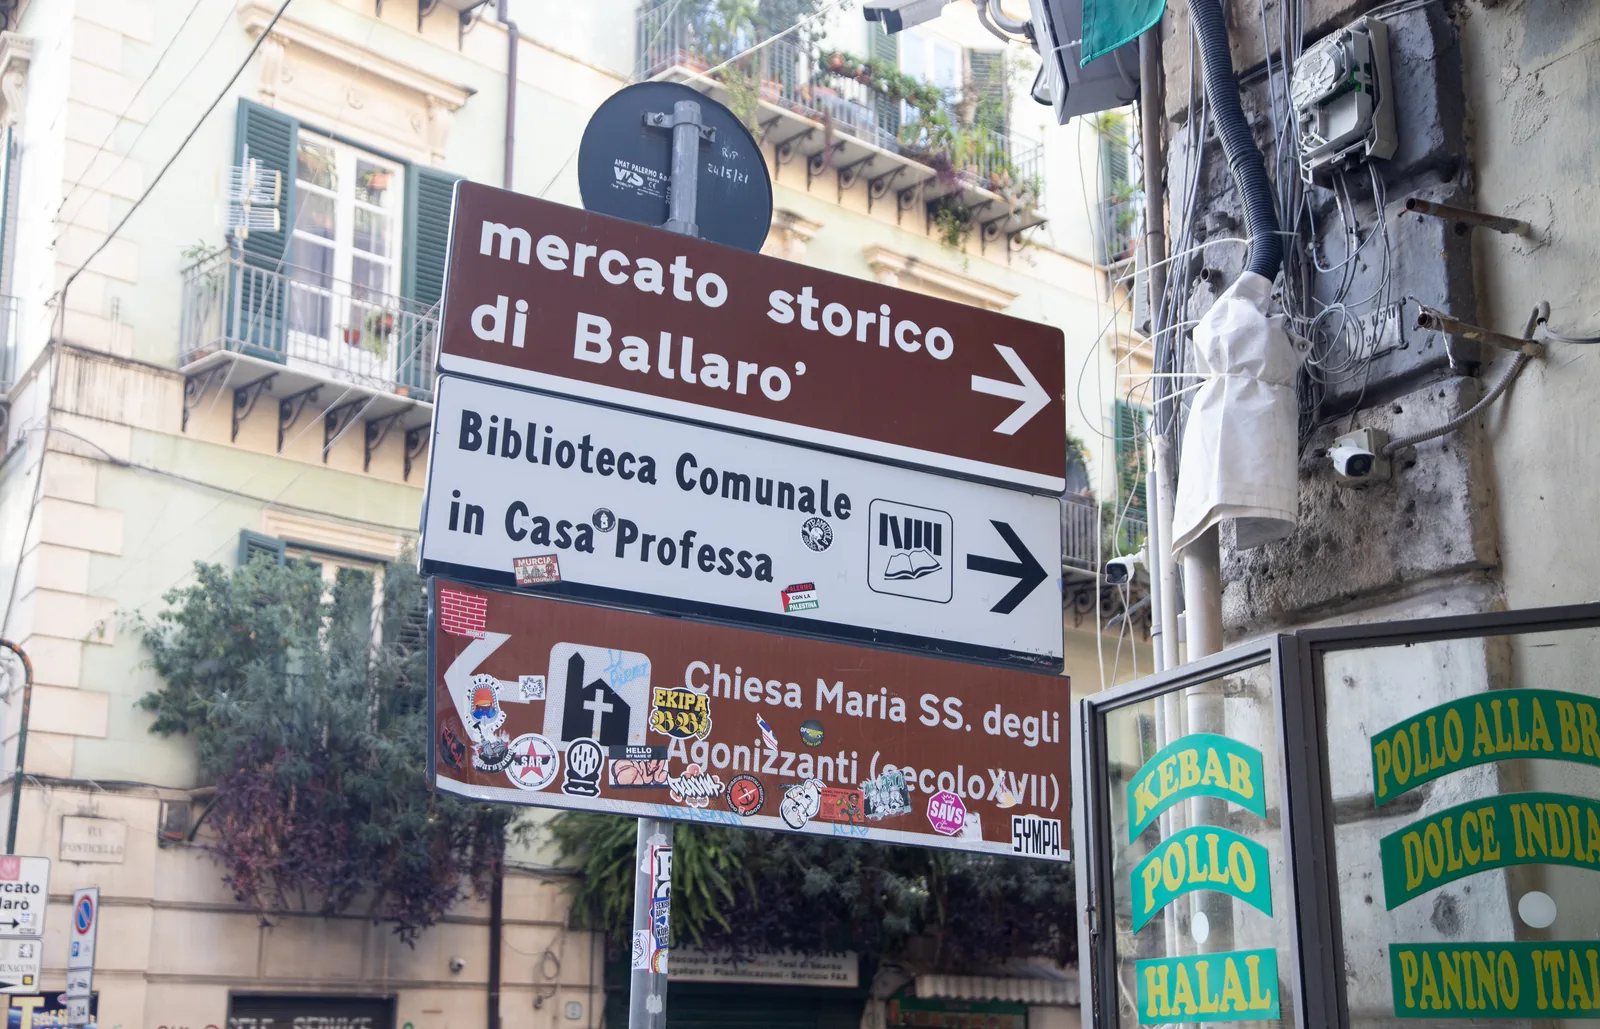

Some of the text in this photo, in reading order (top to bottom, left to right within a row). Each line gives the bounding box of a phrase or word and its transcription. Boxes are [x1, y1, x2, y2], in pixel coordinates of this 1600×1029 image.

[614, 158, 630, 169] AMAT
[632, 163, 657, 178] PALERMO
[480, 220, 954, 361] mercato storico
[471, 295, 529, 348] di
[459, 409, 851, 520] Biblioteca Comunale
[449, 489, 485, 536] in
[505, 500, 595, 554] Casa
[615, 518, 774, 583] Professa
[518, 556, 552, 567] MURCIA
[786, 583, 813, 593] PALERMO
[789, 601, 818, 611] PALESTINA
[654, 689, 707, 712] EKIPA
[685, 660, 802, 709] Chiesa
[815, 678, 907, 723] Maria
[919, 693, 972, 732] SS.
[983, 704, 1060, 747] degli
[521, 756, 543, 768] SAR
[667, 738, 858, 785] Agonizzanti
[1374, 708, 1465, 798] POLLO
[1472, 697, 1555, 757] ALLA
[930, 800, 963, 825] SAVS
[1135, 747, 1255, 826] KEBAB
[1013, 818, 1060, 855] SYMPA
[1401, 806, 1501, 892] DOLCE
[1141, 833, 1256, 914] POLLO
[1144, 955, 1271, 1018] HALAL
[1399, 950, 1520, 1011] PANINO
